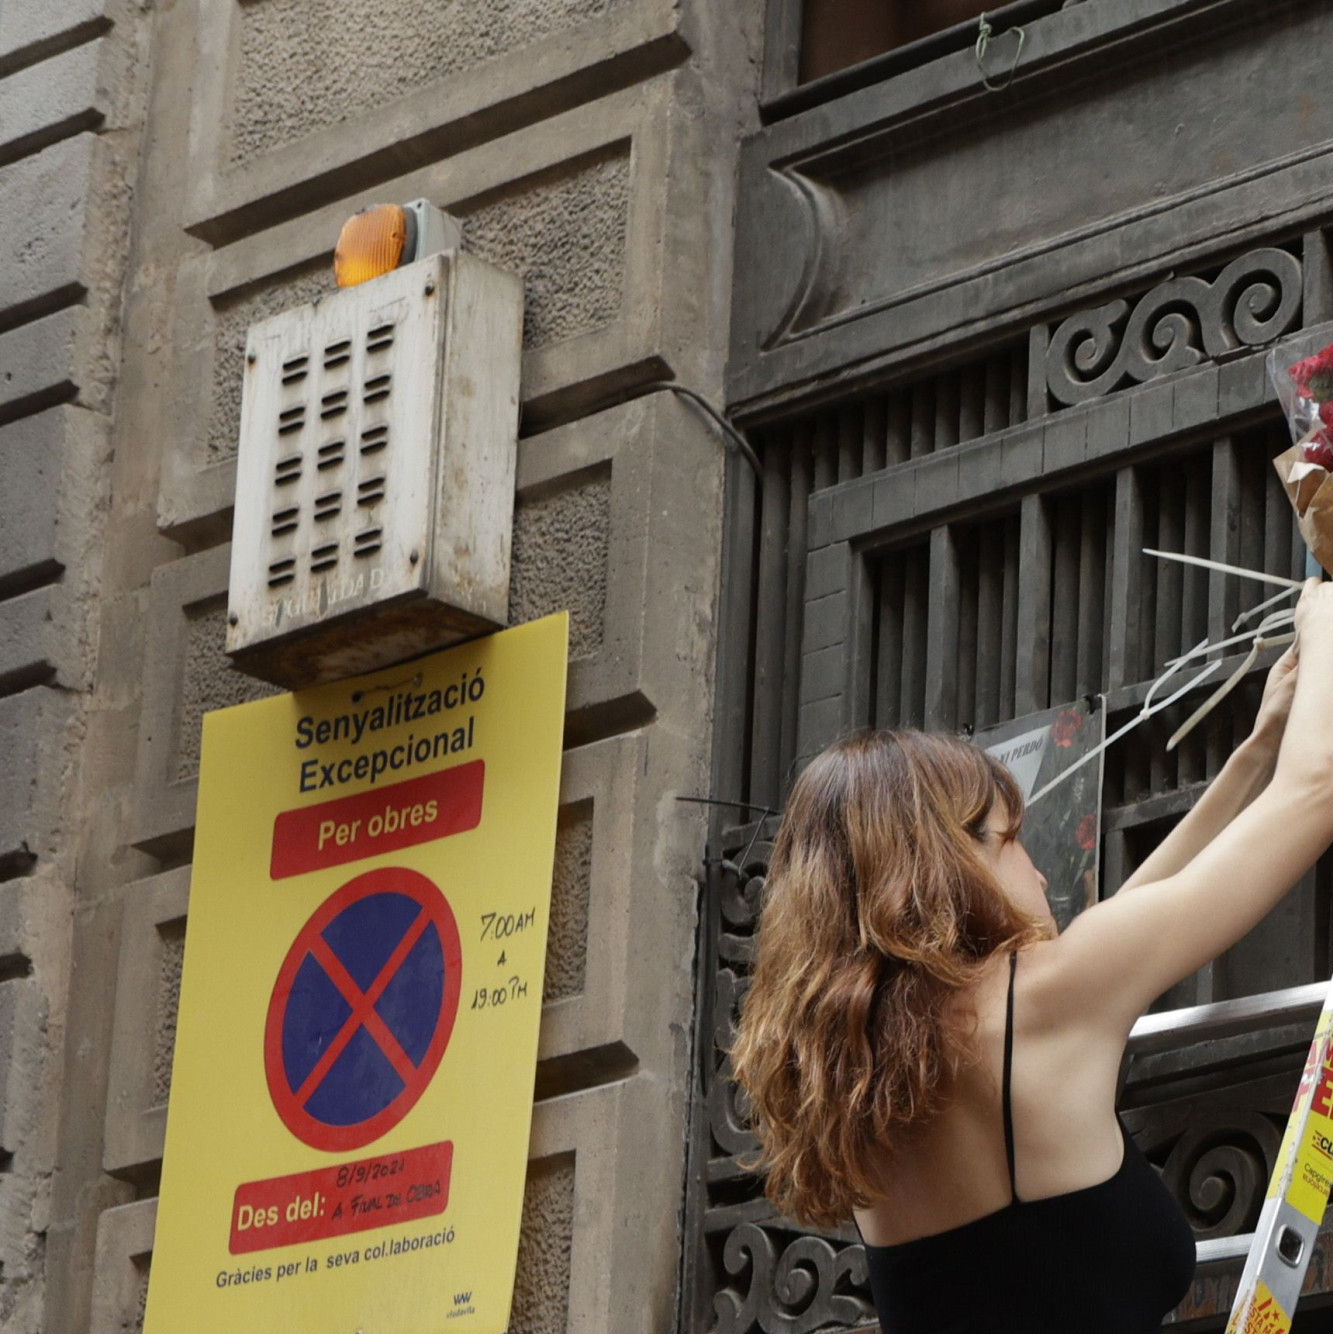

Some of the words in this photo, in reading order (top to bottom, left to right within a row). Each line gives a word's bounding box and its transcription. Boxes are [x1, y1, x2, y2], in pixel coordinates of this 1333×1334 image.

[295, 667, 485, 749] Senyalització
[299, 715, 475, 793] Excepcional
[318, 820, 362, 851] Per
[367, 799, 438, 838] obres
[237, 1205, 279, 1231] Des
[285, 1191, 326, 1222] del:
[215, 1265, 272, 1289] Gràcies
[276, 1260, 301, 1282] per
[306, 1256, 318, 1273] la
[326, 1249, 360, 1269] seva
[364, 1225, 456, 1261] col.laboració
